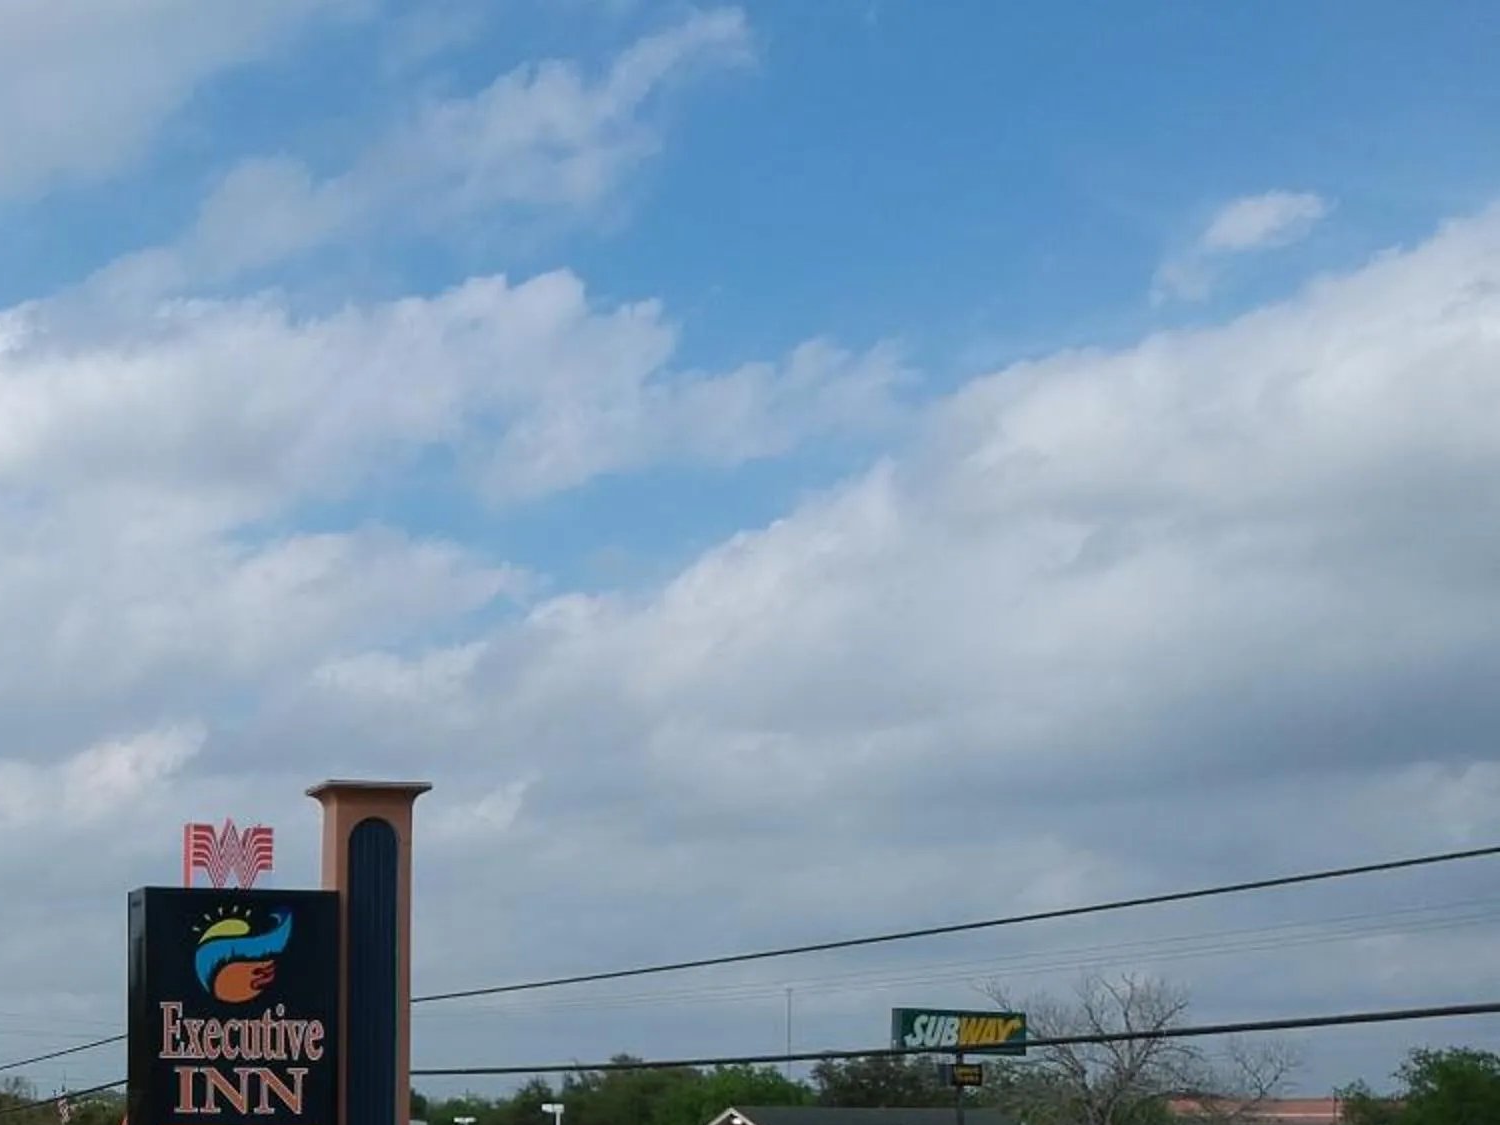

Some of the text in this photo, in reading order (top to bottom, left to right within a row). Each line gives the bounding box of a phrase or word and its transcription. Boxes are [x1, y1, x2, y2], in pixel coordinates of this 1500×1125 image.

[159, 1001, 324, 1061] Executive
[904, 1014, 1023, 1048] SUBWAY
[174, 1066, 309, 1115] INN
